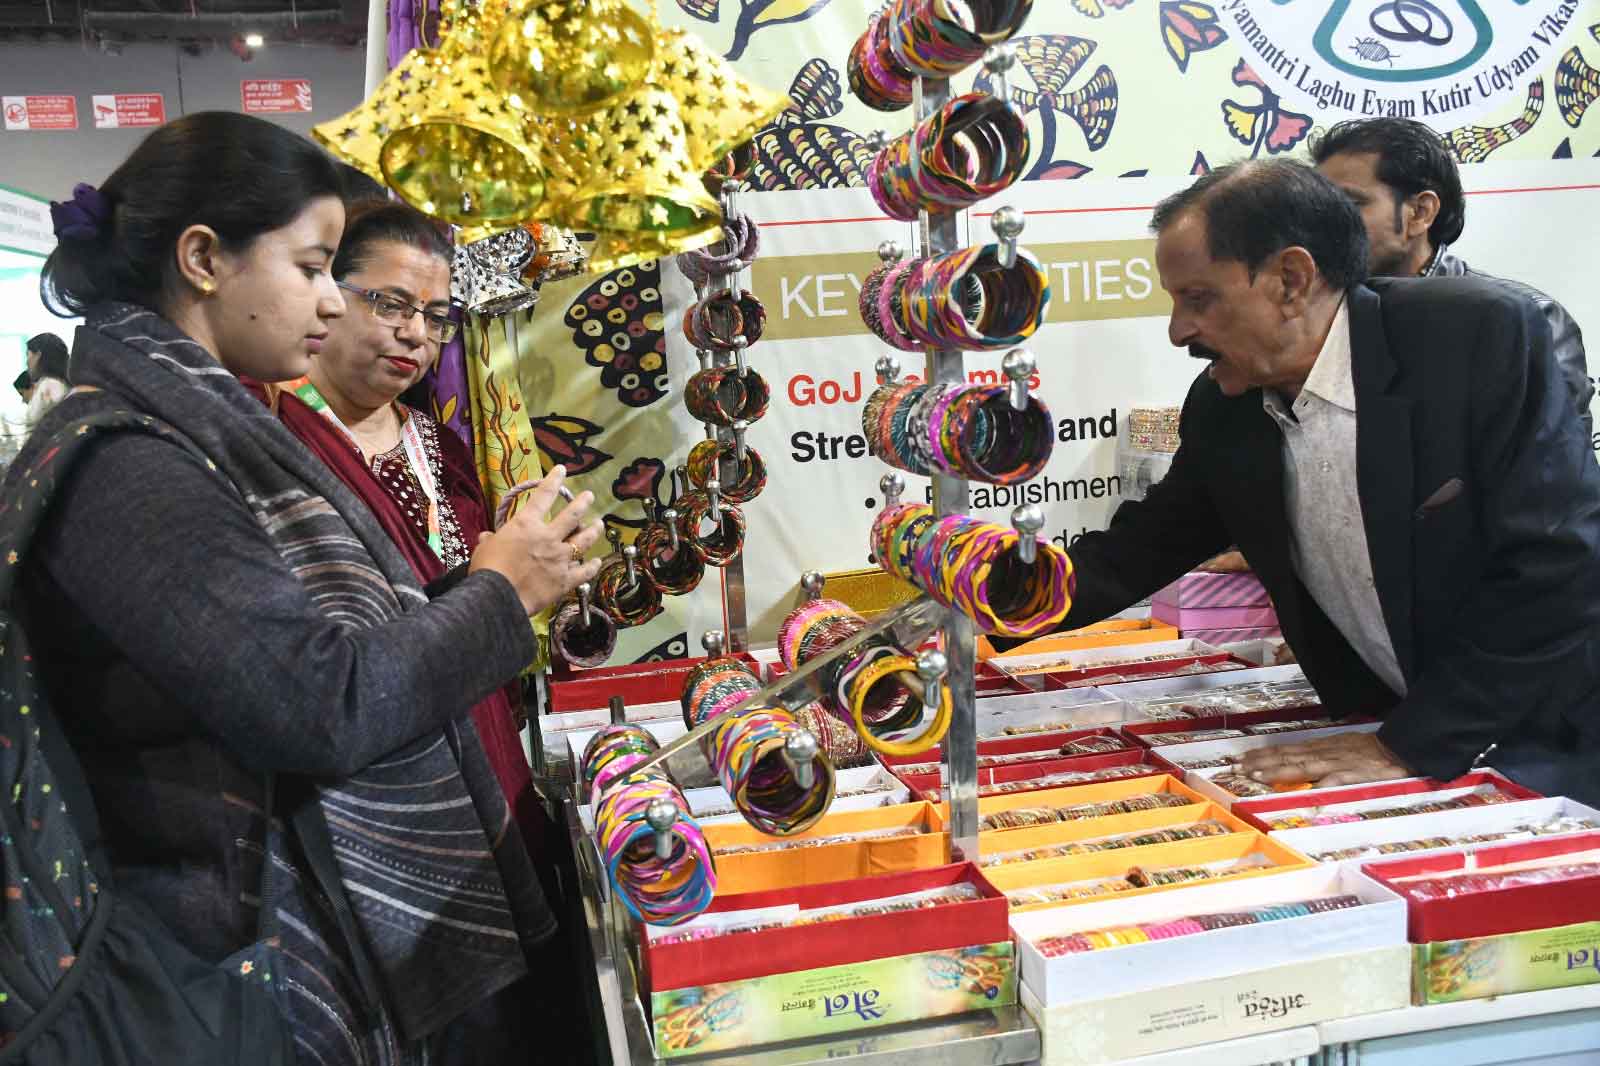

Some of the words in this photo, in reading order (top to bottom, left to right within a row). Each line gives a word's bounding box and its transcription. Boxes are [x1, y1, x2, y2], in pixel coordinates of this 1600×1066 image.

[1295, 65, 1356, 110] Laghu
[1360, 89, 1415, 118] Evam
[1421, 83, 1472, 116] Kutir
[1473, 45, 1540, 97] Udyam
[787, 371, 862, 407] GoJ
[1058, 408, 1118, 442] and
